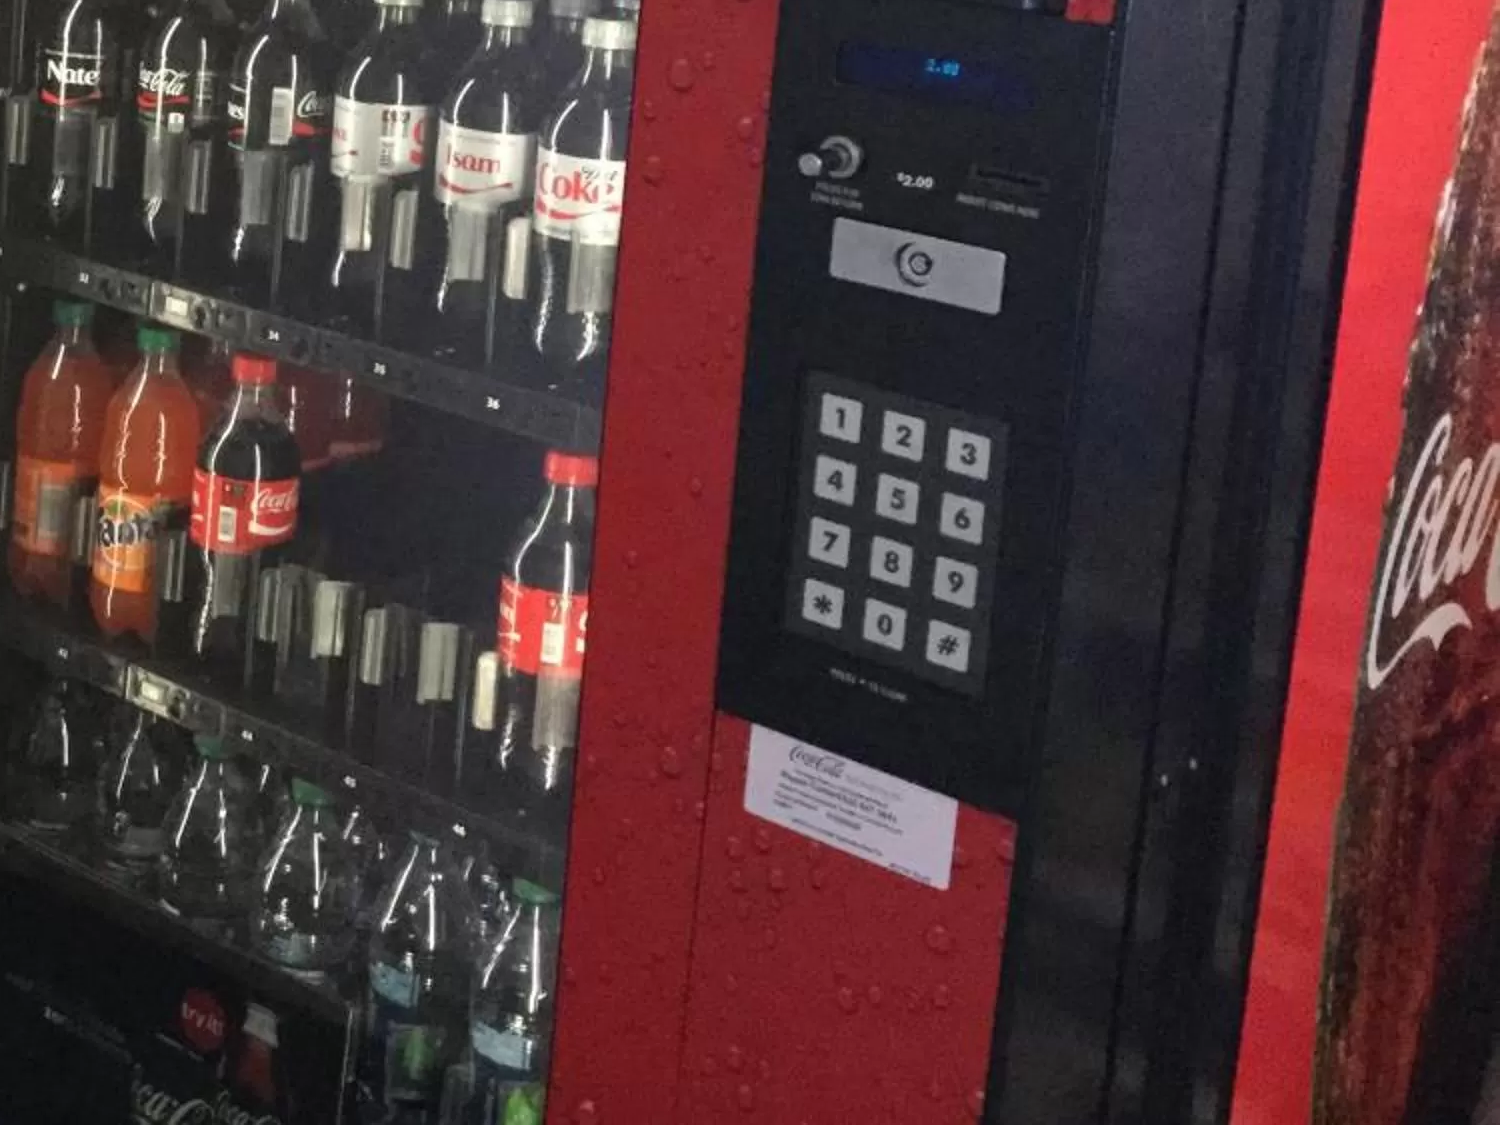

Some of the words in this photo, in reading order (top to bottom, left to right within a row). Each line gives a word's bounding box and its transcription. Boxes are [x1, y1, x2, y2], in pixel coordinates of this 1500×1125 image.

[835, 407, 846, 429] 1
[896, 424, 913, 448] 2
[959, 443, 978, 466] 3
[827, 470, 843, 491] 4
[890, 488, 906, 511] 5
[954, 507, 971, 530] 6
[820, 530, 839, 552] 7
[882, 550, 900, 573] 8
[947, 571, 965, 594] 9
[876, 613, 894, 637] 0
